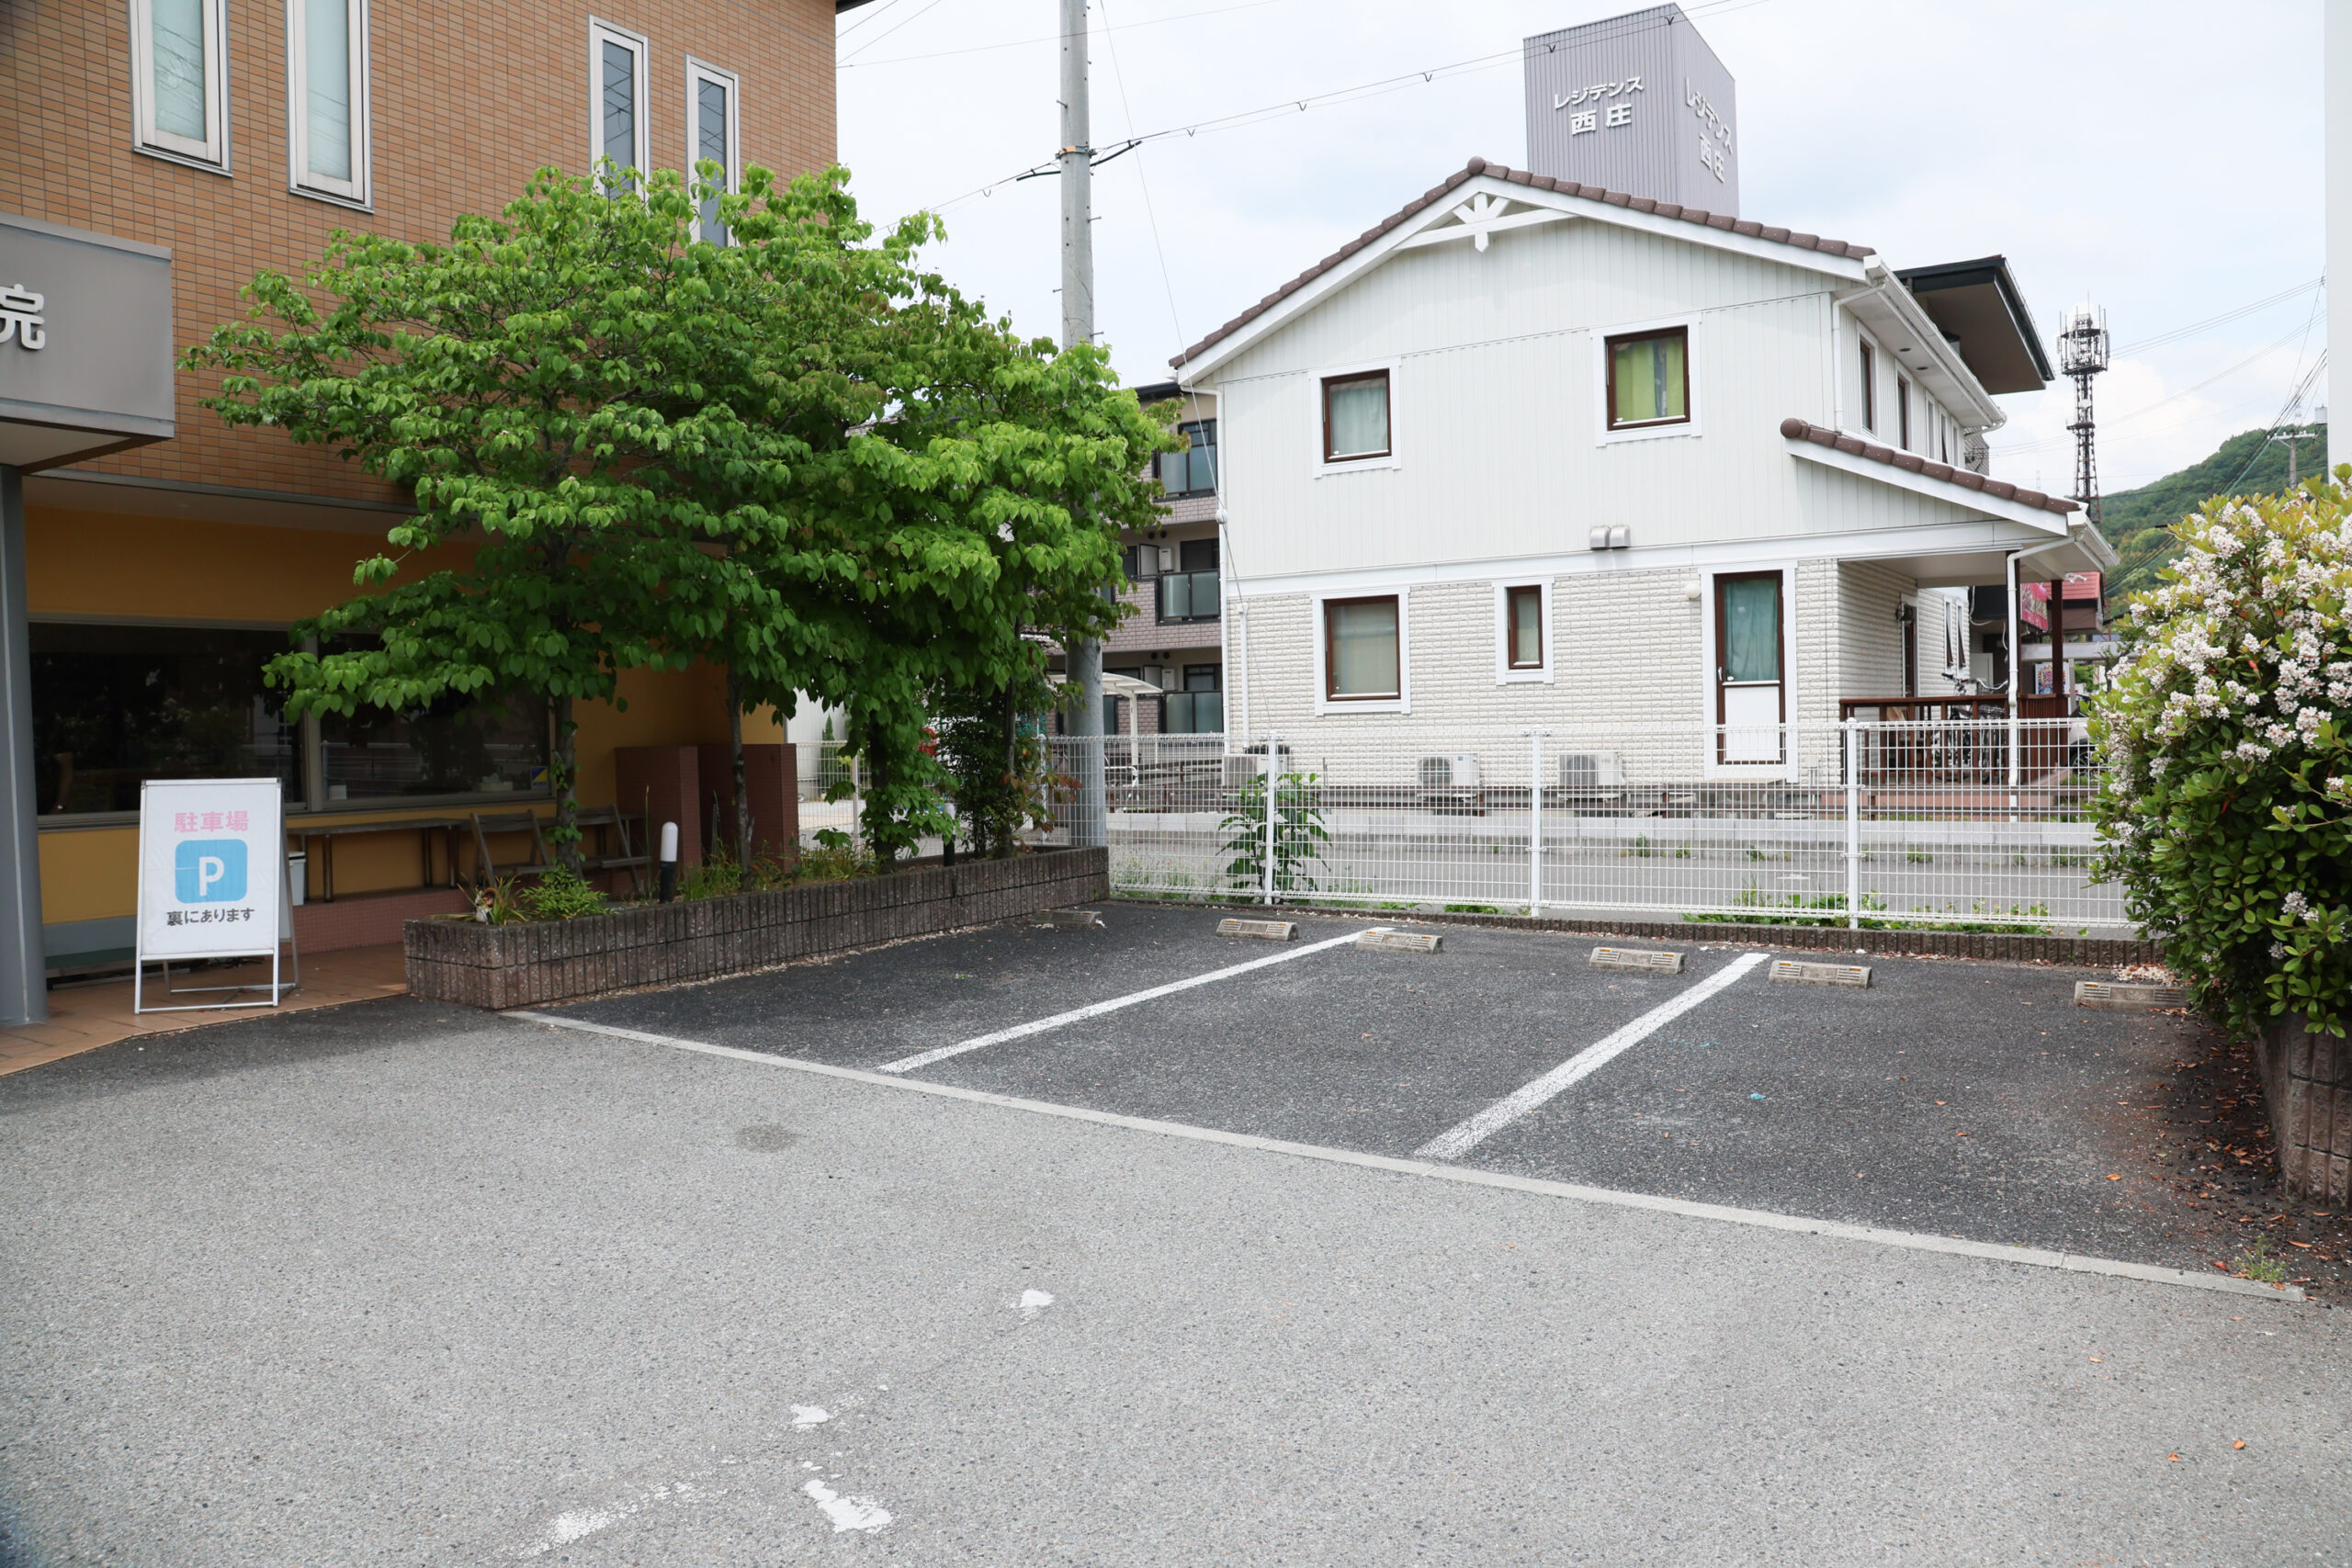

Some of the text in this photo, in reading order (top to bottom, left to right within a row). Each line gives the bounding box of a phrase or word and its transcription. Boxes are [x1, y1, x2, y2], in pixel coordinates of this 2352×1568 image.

[1554, 76, 1645, 110] レジデンス
[1570, 103, 1633, 136] 西庄
[1685, 76, 1734, 155] レジデンス
[1699, 132, 1725, 184] 西庄
[174, 810, 250, 833] 駐車場
[198, 856, 225, 897] P
[166, 908, 255, 927] 裏にあります
